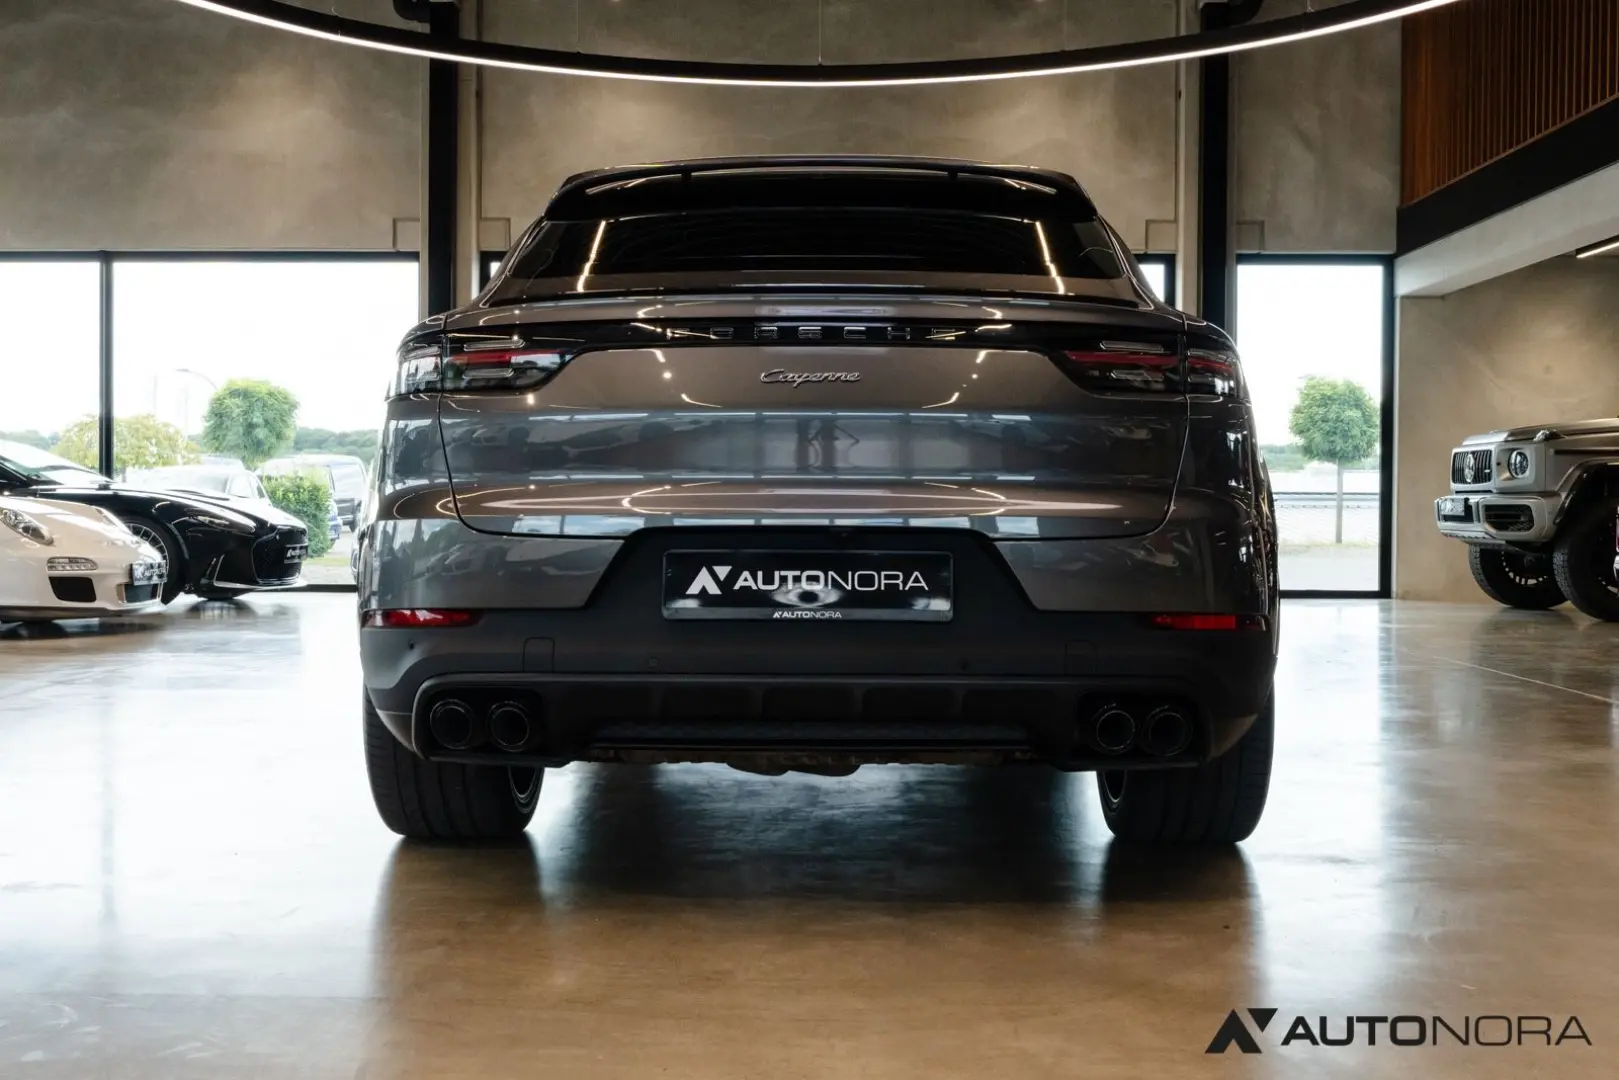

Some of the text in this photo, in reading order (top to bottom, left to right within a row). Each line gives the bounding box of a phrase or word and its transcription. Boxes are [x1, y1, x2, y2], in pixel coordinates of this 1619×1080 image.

[760, 369, 861, 387] Cayenne
[733, 570, 929, 591] AUTONORA
[781, 610, 842, 619] AUTONORA
